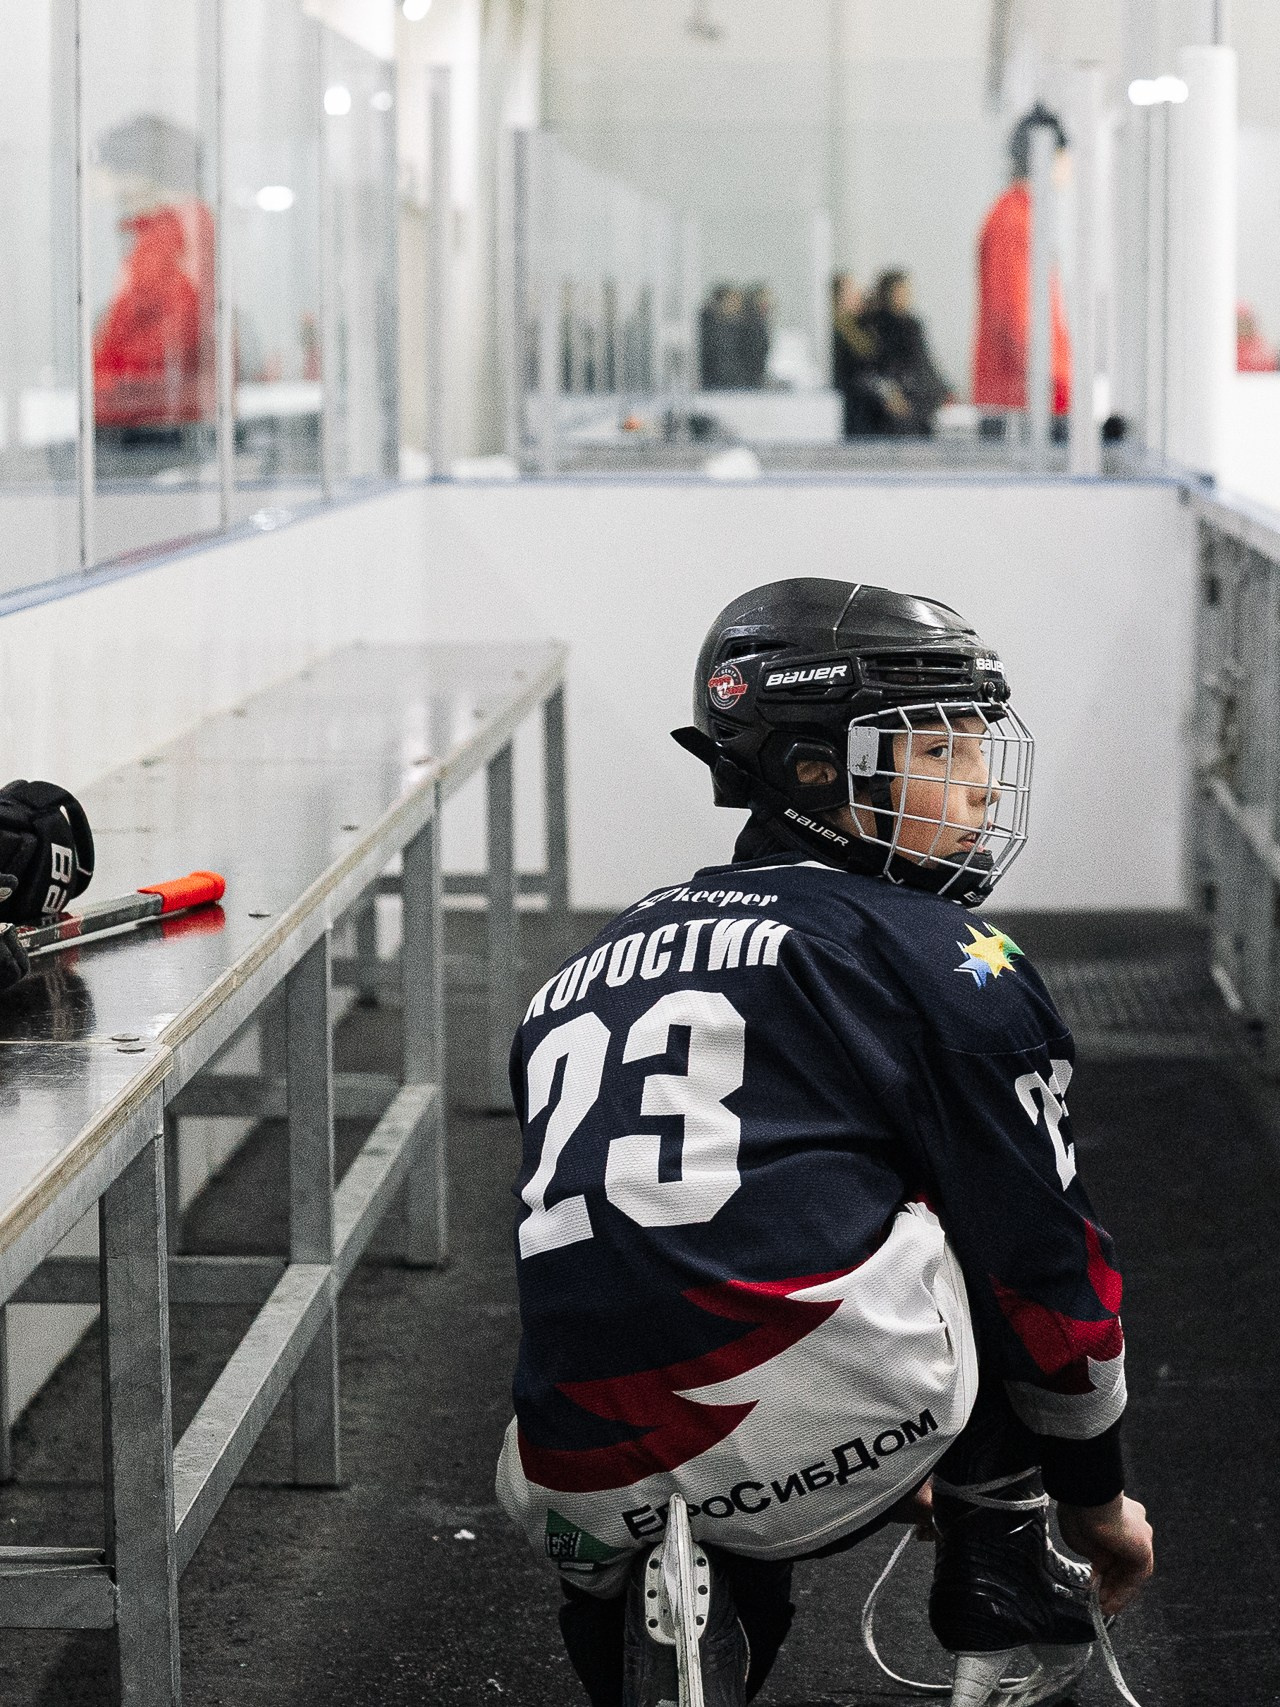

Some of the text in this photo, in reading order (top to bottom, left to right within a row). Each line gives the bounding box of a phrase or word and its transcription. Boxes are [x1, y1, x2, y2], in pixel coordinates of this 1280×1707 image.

[765, 665, 849, 687] BAUER
[783, 808, 850, 847] BAUER
[517, 989, 747, 1261] 23
